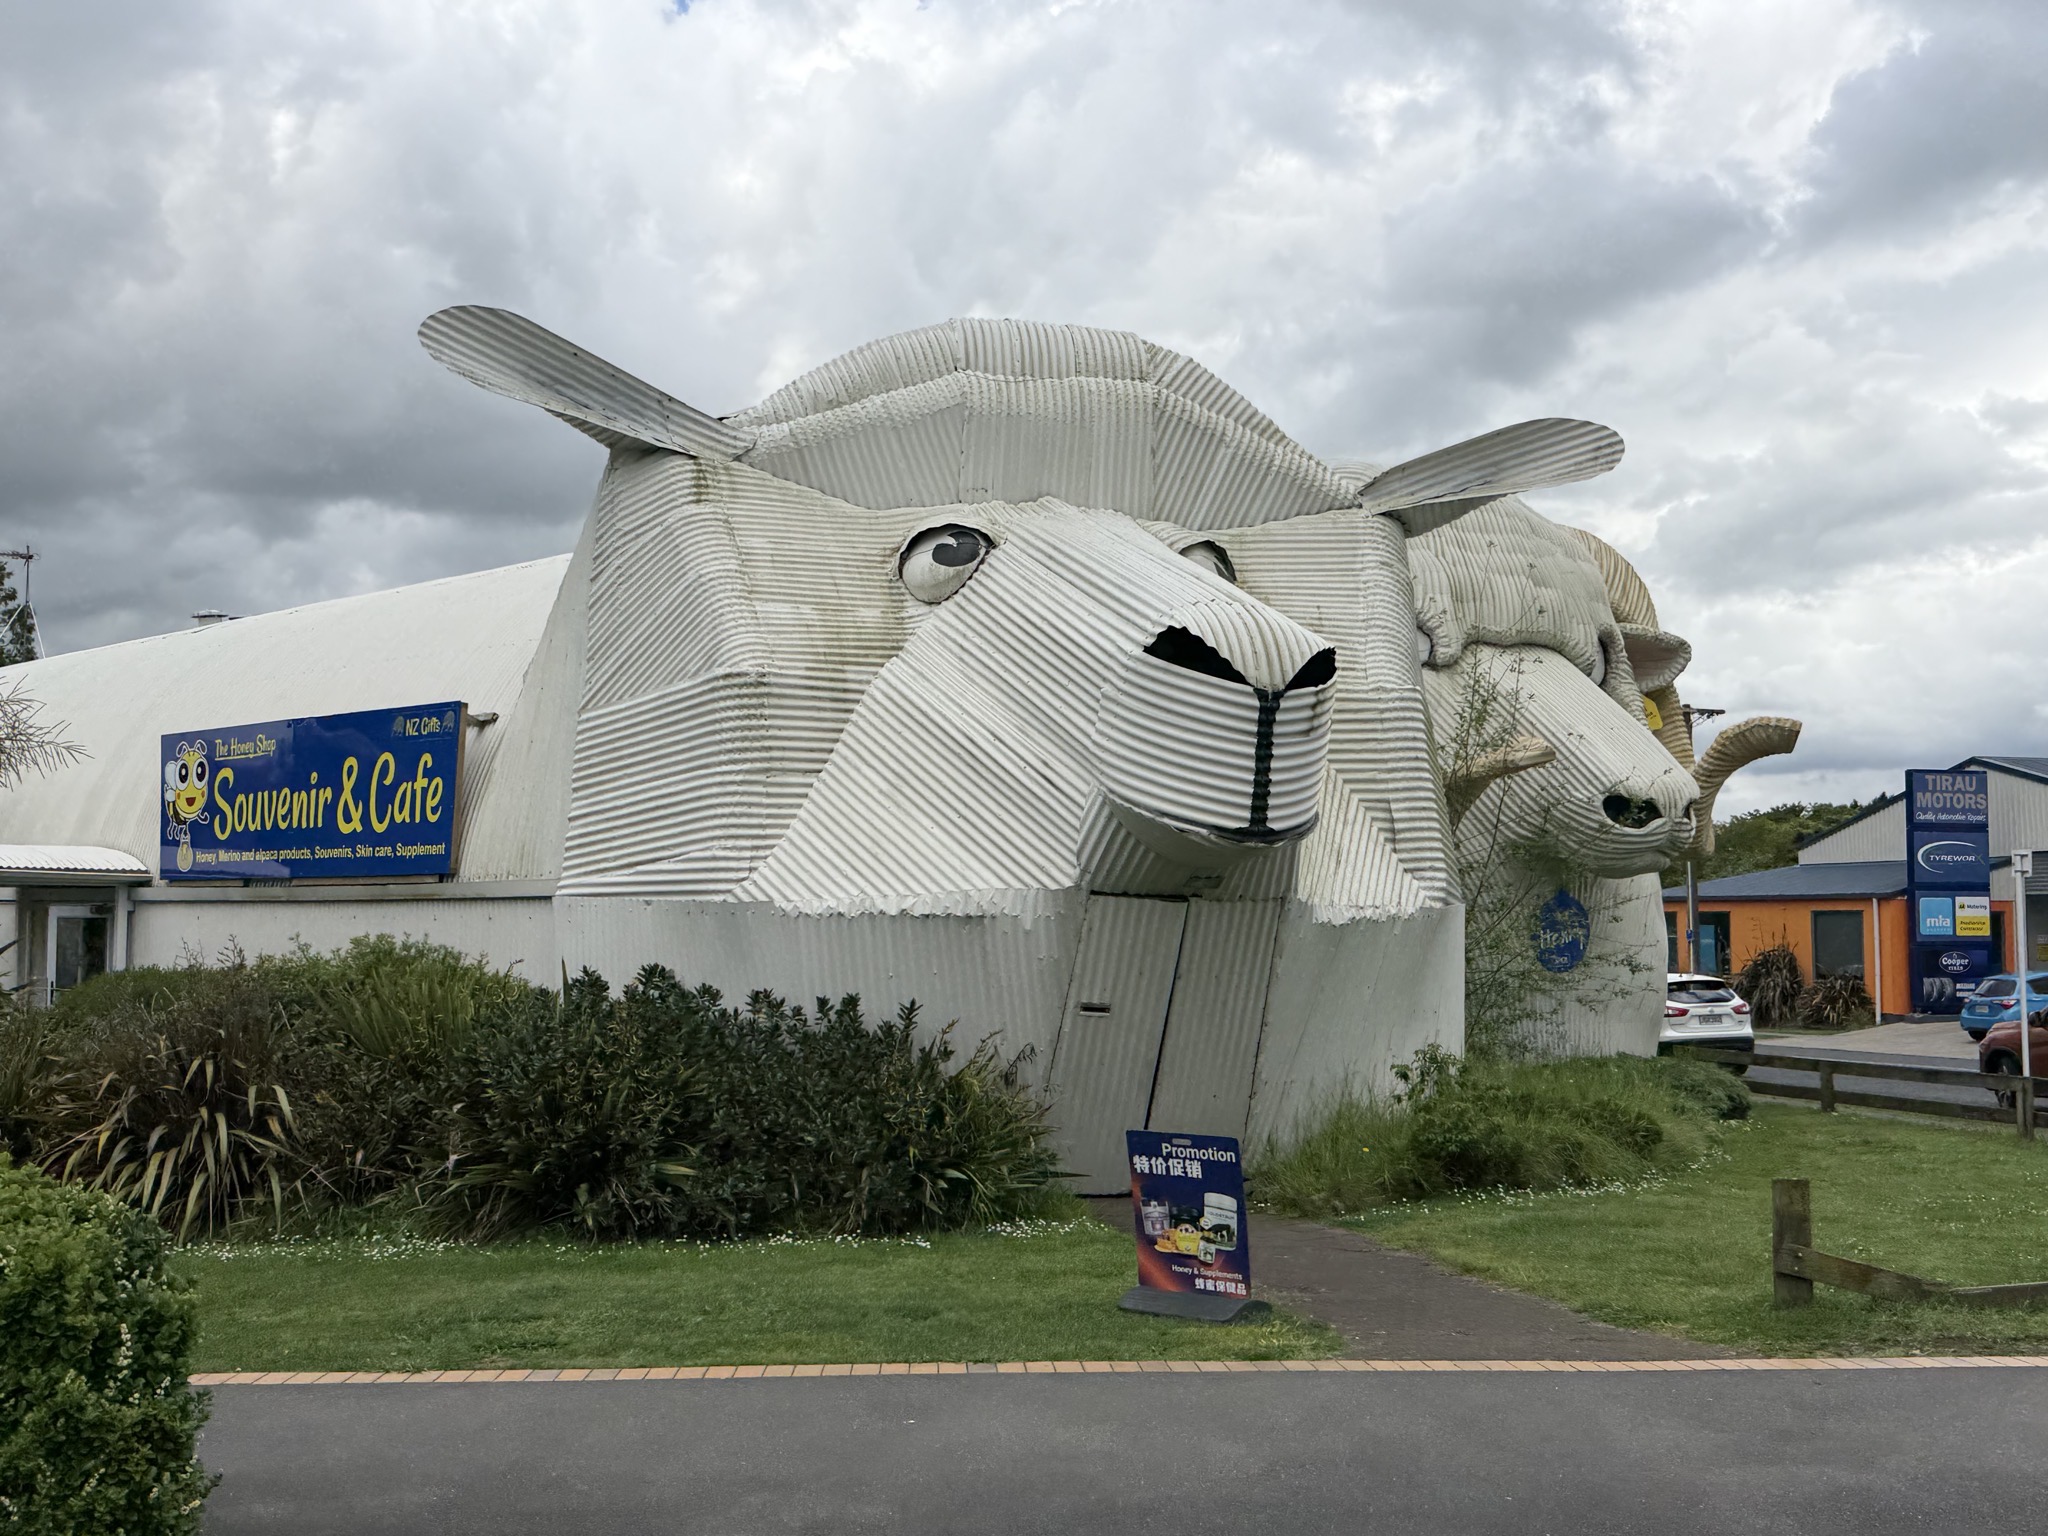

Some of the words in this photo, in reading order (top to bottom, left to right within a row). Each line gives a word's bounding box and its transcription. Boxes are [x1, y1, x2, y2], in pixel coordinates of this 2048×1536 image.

[405, 718, 419, 737] NZ
[420, 716, 441, 735] Gifts
[214, 739, 228, 757] The
[230, 737, 255, 756] Honey
[256, 733, 277, 757] Shop
[1925, 774, 1976, 792] TIRAU
[213, 767, 333, 841] Souvenir
[336, 756, 363, 835] &
[369, 751, 443, 834] Cafe
[1916, 791, 1988, 810] MOTORS
[1915, 811, 1936, 823] Quality
[1936, 811, 1966, 821] Automotive
[1966, 812, 1987, 824] Repairs
[195, 851, 218, 866] Honey,
[218, 849, 241, 863] Merino
[241, 849, 255, 861] and
[255, 848, 279, 864] alpaca
[278, 846, 313, 864] products,
[314, 845, 354, 860] Souvenirs,
[355, 843, 373, 858] Skin
[374, 845, 395, 859] care,
[395, 842, 446, 860] Supplement
[1941, 957, 1970, 966] Cooper
[1161, 1142, 1236, 1163] Promotion
[1132, 1154, 1203, 1179] 特价促销
[1171, 1264, 1192, 1276] Honey
[1193, 1267, 1199, 1275] &
[1200, 1267, 1243, 1281] Supplements
